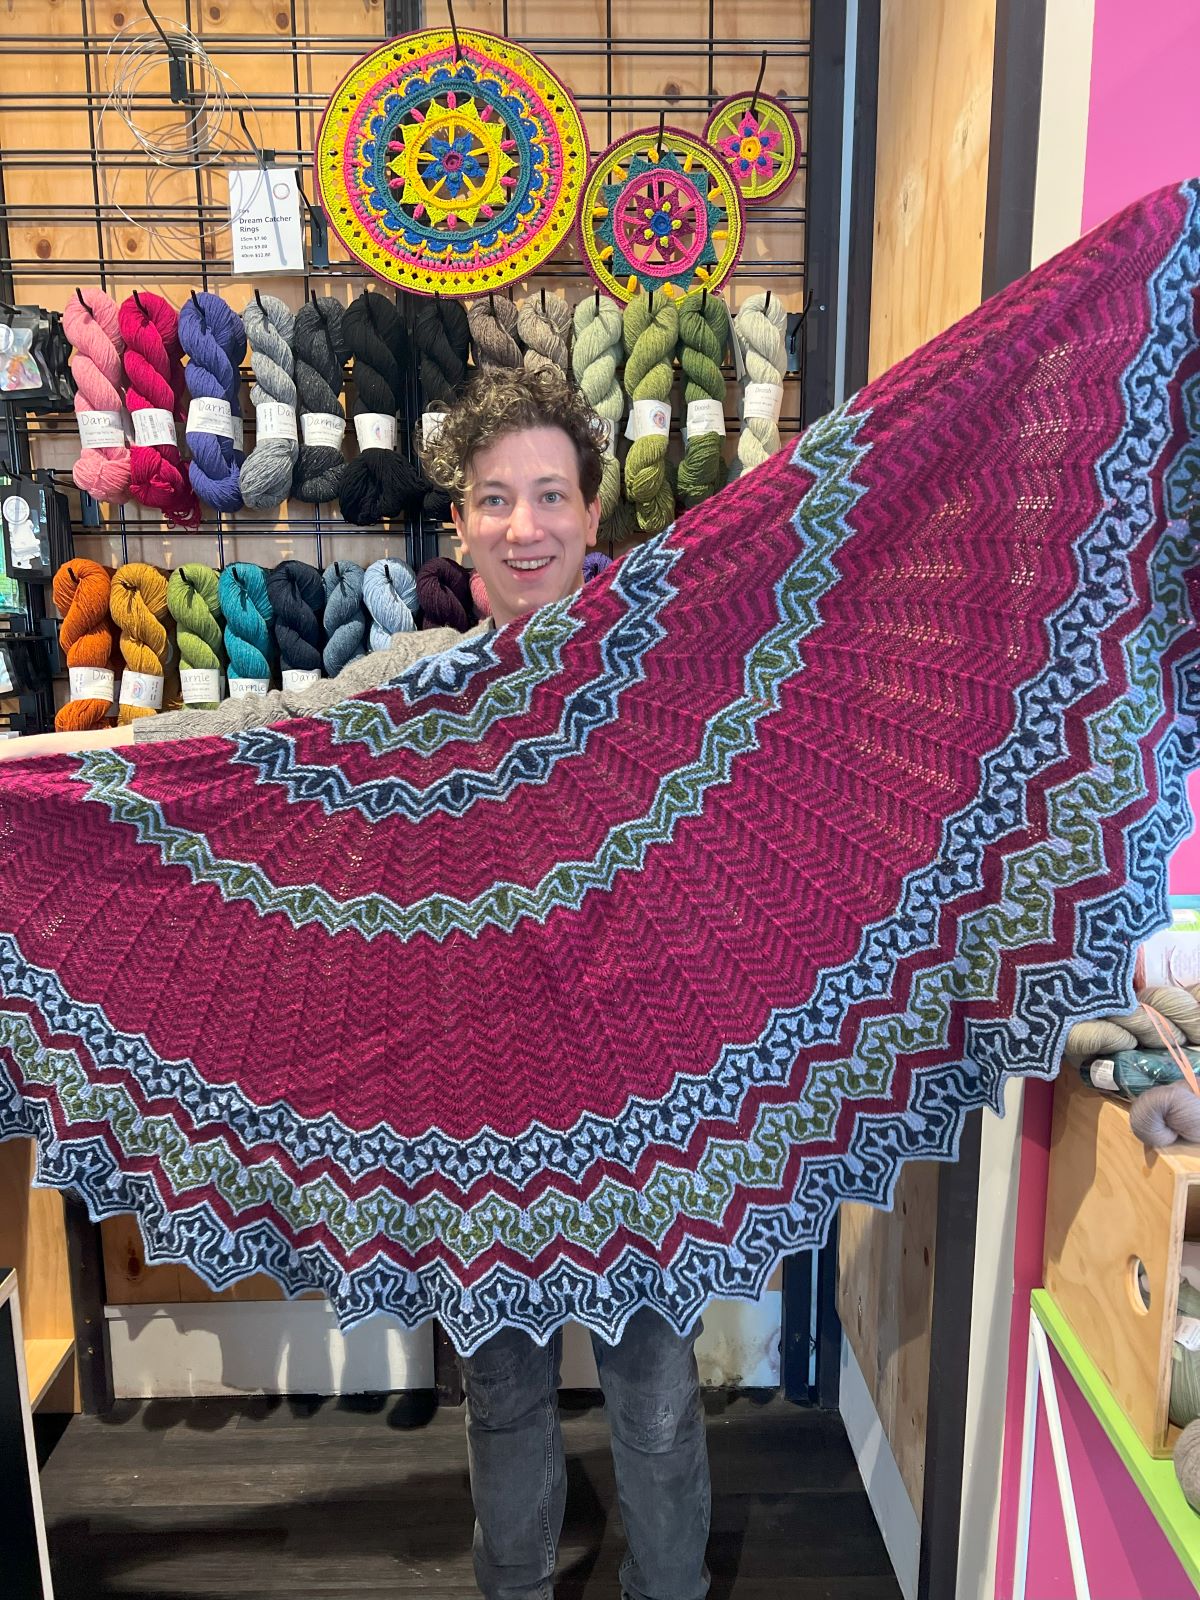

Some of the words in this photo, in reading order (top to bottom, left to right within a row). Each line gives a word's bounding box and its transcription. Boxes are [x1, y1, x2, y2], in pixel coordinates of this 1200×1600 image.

[264, 215, 292, 223] Catcher
[239, 226, 260, 234] Rings
[307, 415, 341, 429] Darnie
[231, 681, 266, 692] Darnie
